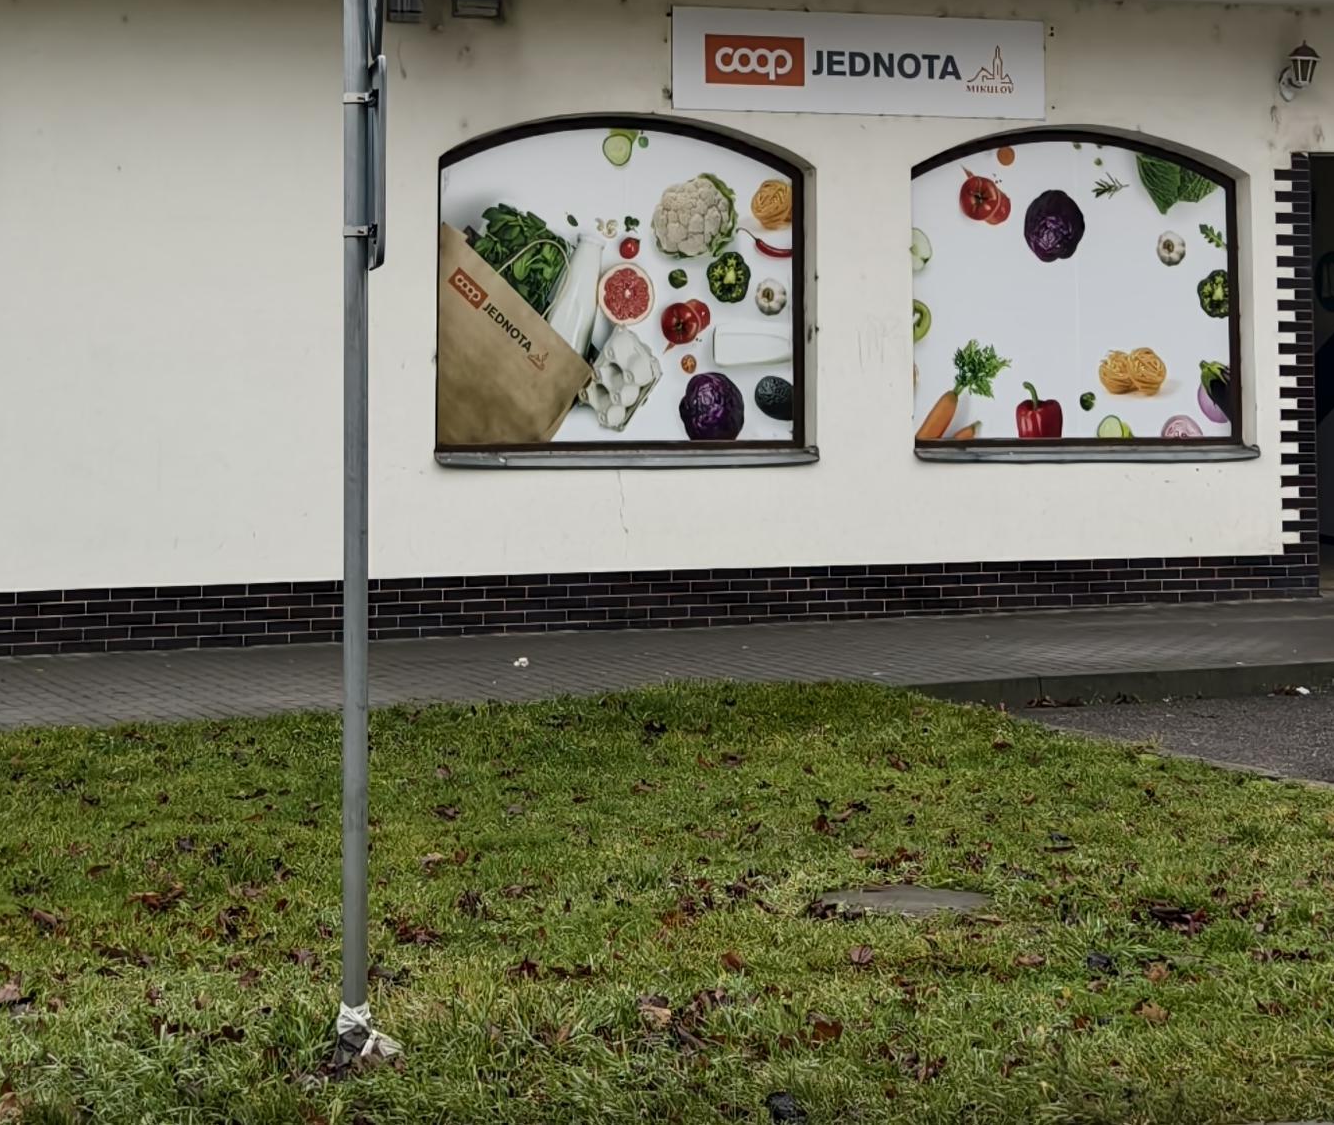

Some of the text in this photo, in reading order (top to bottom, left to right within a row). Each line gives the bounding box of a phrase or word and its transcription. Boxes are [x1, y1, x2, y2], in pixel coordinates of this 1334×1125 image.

[714, 46, 962, 81] coop JEDNOTA
[965, 83, 1014, 95] MIKULOV
[454, 274, 532, 353] coop JEDNOTA
